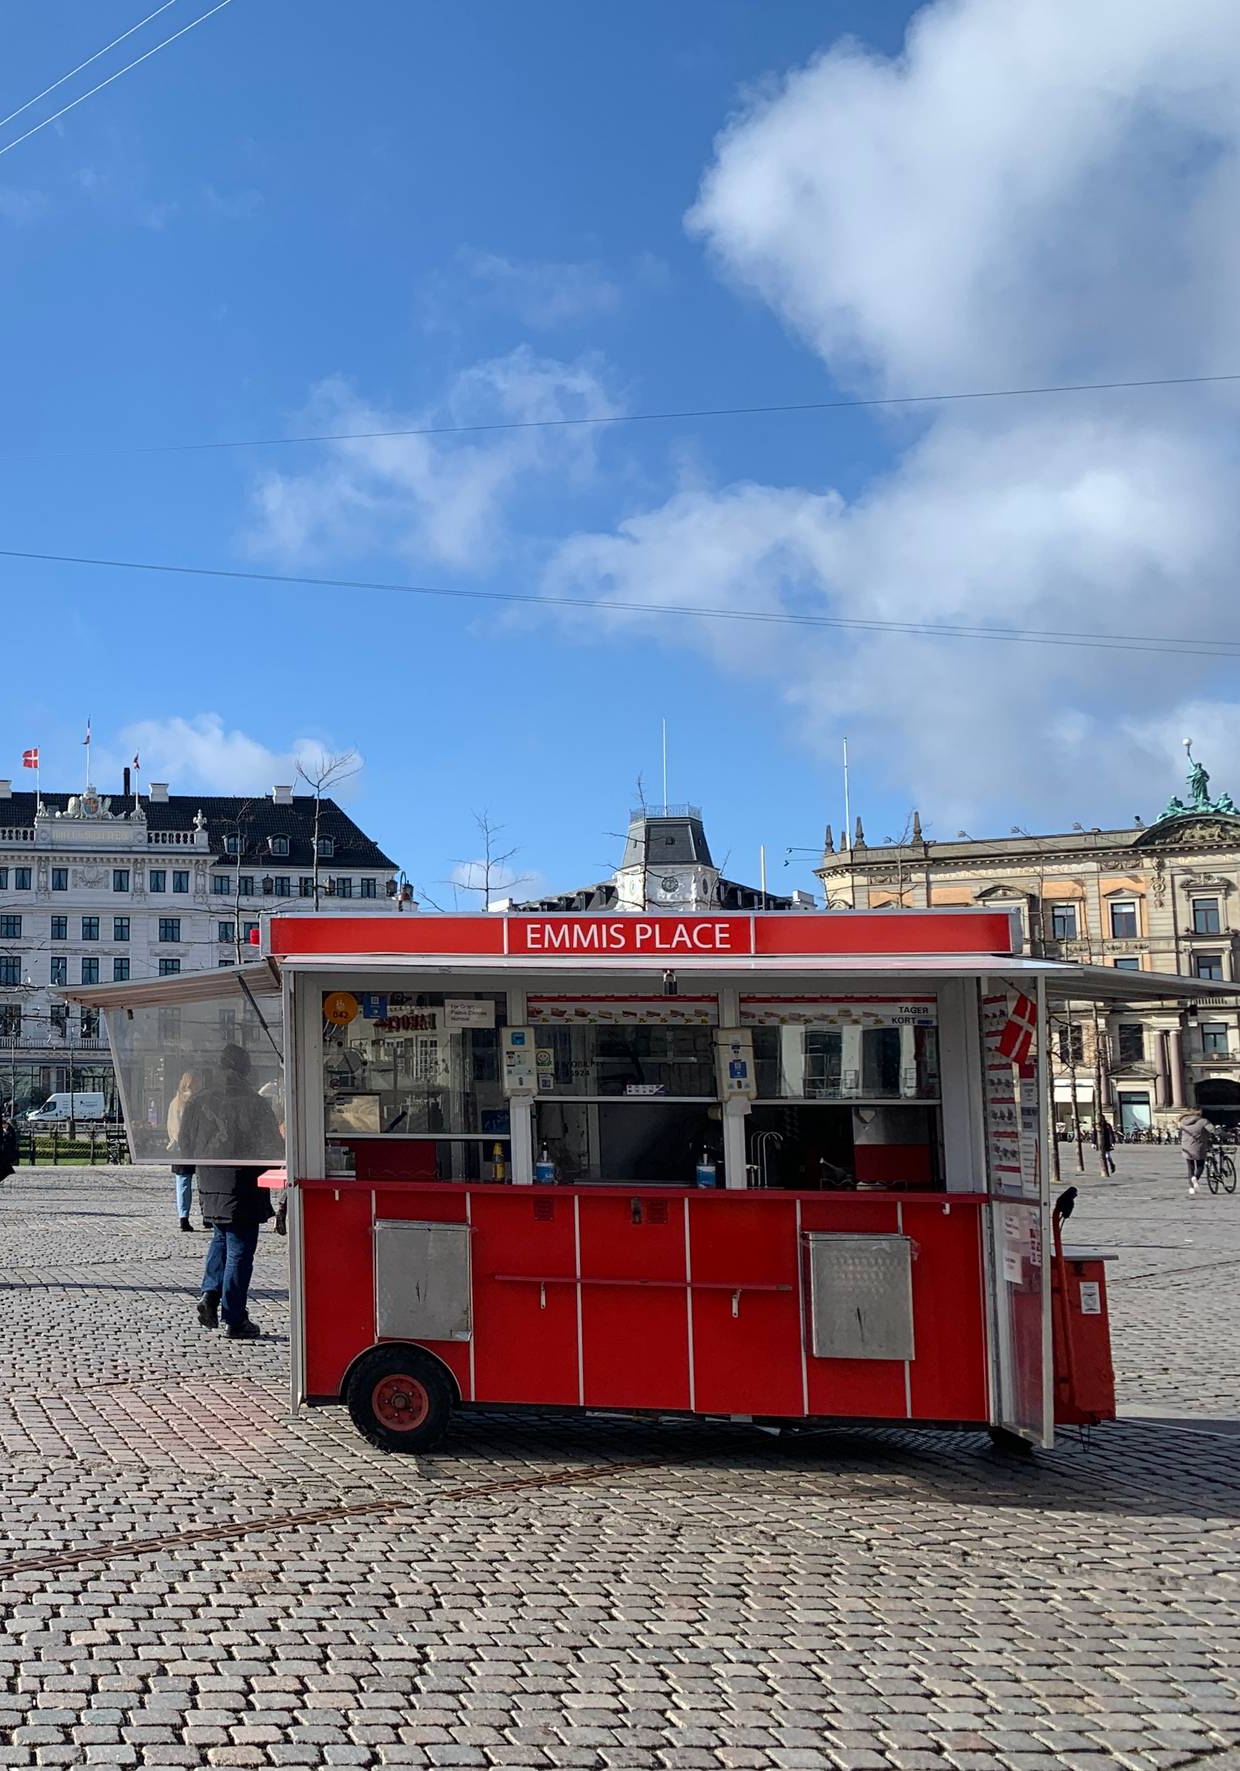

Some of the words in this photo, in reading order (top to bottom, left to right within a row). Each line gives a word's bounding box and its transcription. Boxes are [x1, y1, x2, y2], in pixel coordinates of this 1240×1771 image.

[526, 923, 626, 949] EMMIS
[635, 923, 732, 949] PLACE
[898, 1006, 929, 1014] TAGER
